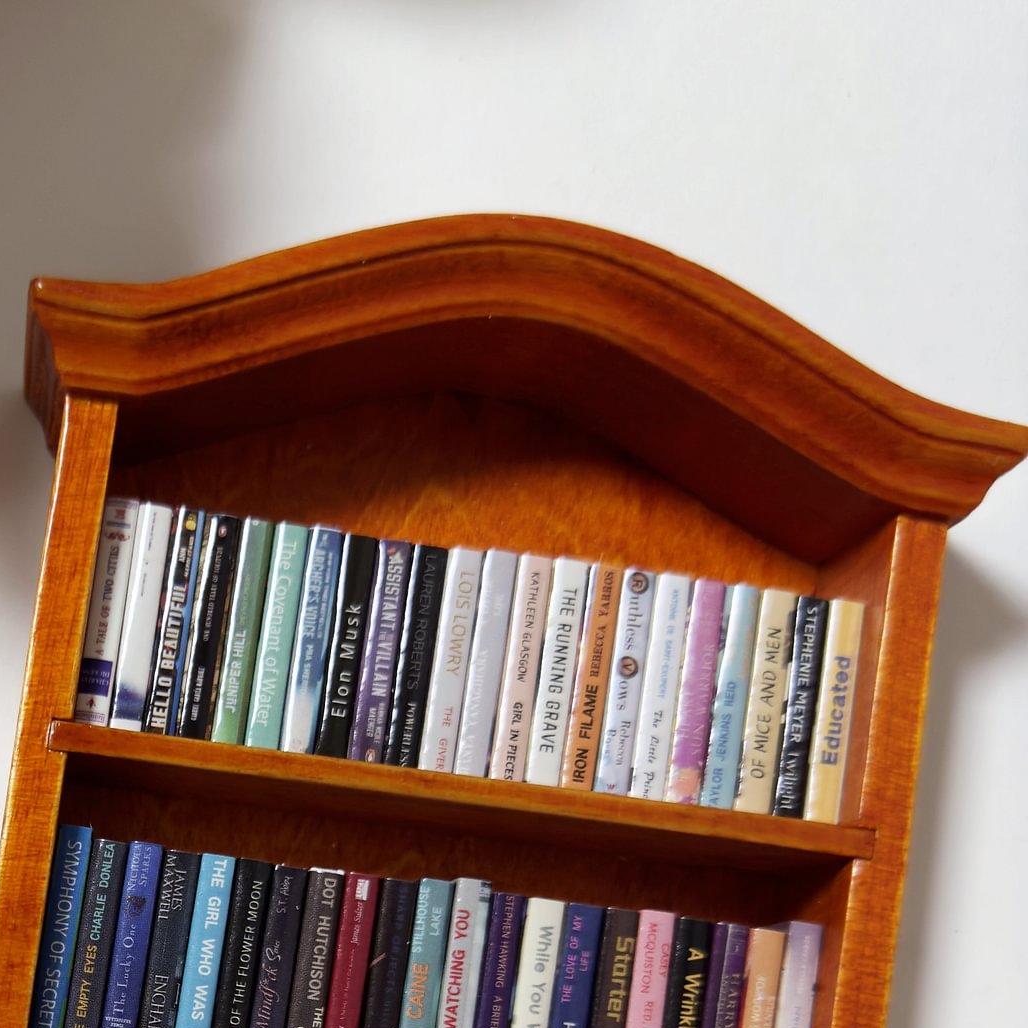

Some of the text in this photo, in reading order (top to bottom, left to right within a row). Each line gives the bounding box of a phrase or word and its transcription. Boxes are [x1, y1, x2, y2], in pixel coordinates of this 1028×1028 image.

[106, 545, 119, 576] CITIES
[102, 578, 114, 600] TWO
[95, 621, 108, 644] TALE
[99, 605, 111, 619] OF
[589, 570, 614, 677] REBECCA YARROS
[233, 629, 246, 657] HILL
[255, 539, 297, 727] The Covenant of Water
[150, 582, 187, 728] HELLO BEAUTIFUL
[330, 602, 361, 717] Elon Musk
[539, 586, 577, 753] THE RUNNING GRAVE
[789, 606, 819, 743] STEPHENIE MEYER
[224, 661, 243, 712] JUNIPER
[749, 627, 782, 779] OF MICE AND MEN
[820, 655, 851, 766] Educated
[503, 702, 523, 780] GIRL IN PIECES
[778, 751, 801, 810] twilight
[52, 839, 82, 936] SYMPHONY
[168, 868, 187, 911] JAMES
[210, 858, 227, 888] THE
[203, 895, 221, 930] GIRL
[246, 879, 263, 922] MOON
[306, 877, 337, 1001] DOT HUTCHISON
[454, 908, 470, 941] YOU
[47, 939, 66, 964] OF
[83, 944, 97, 973] EYES
[196, 937, 215, 976] WHO
[237, 925, 255, 976] FLOWER
[561, 915, 582, 1003] THE LOVE OF MY
[579, 950, 590, 971] LIFE
[687, 947, 704, 962] A
[76, 978, 92, 1018] EMPTY
[232, 980, 246, 1004] THE
[606, 935, 632, 1023] Starter
[190, 983, 208, 1021] WAS
[229, 1008, 242, 1025] OF
[311, 1006, 324, 1028] THE
